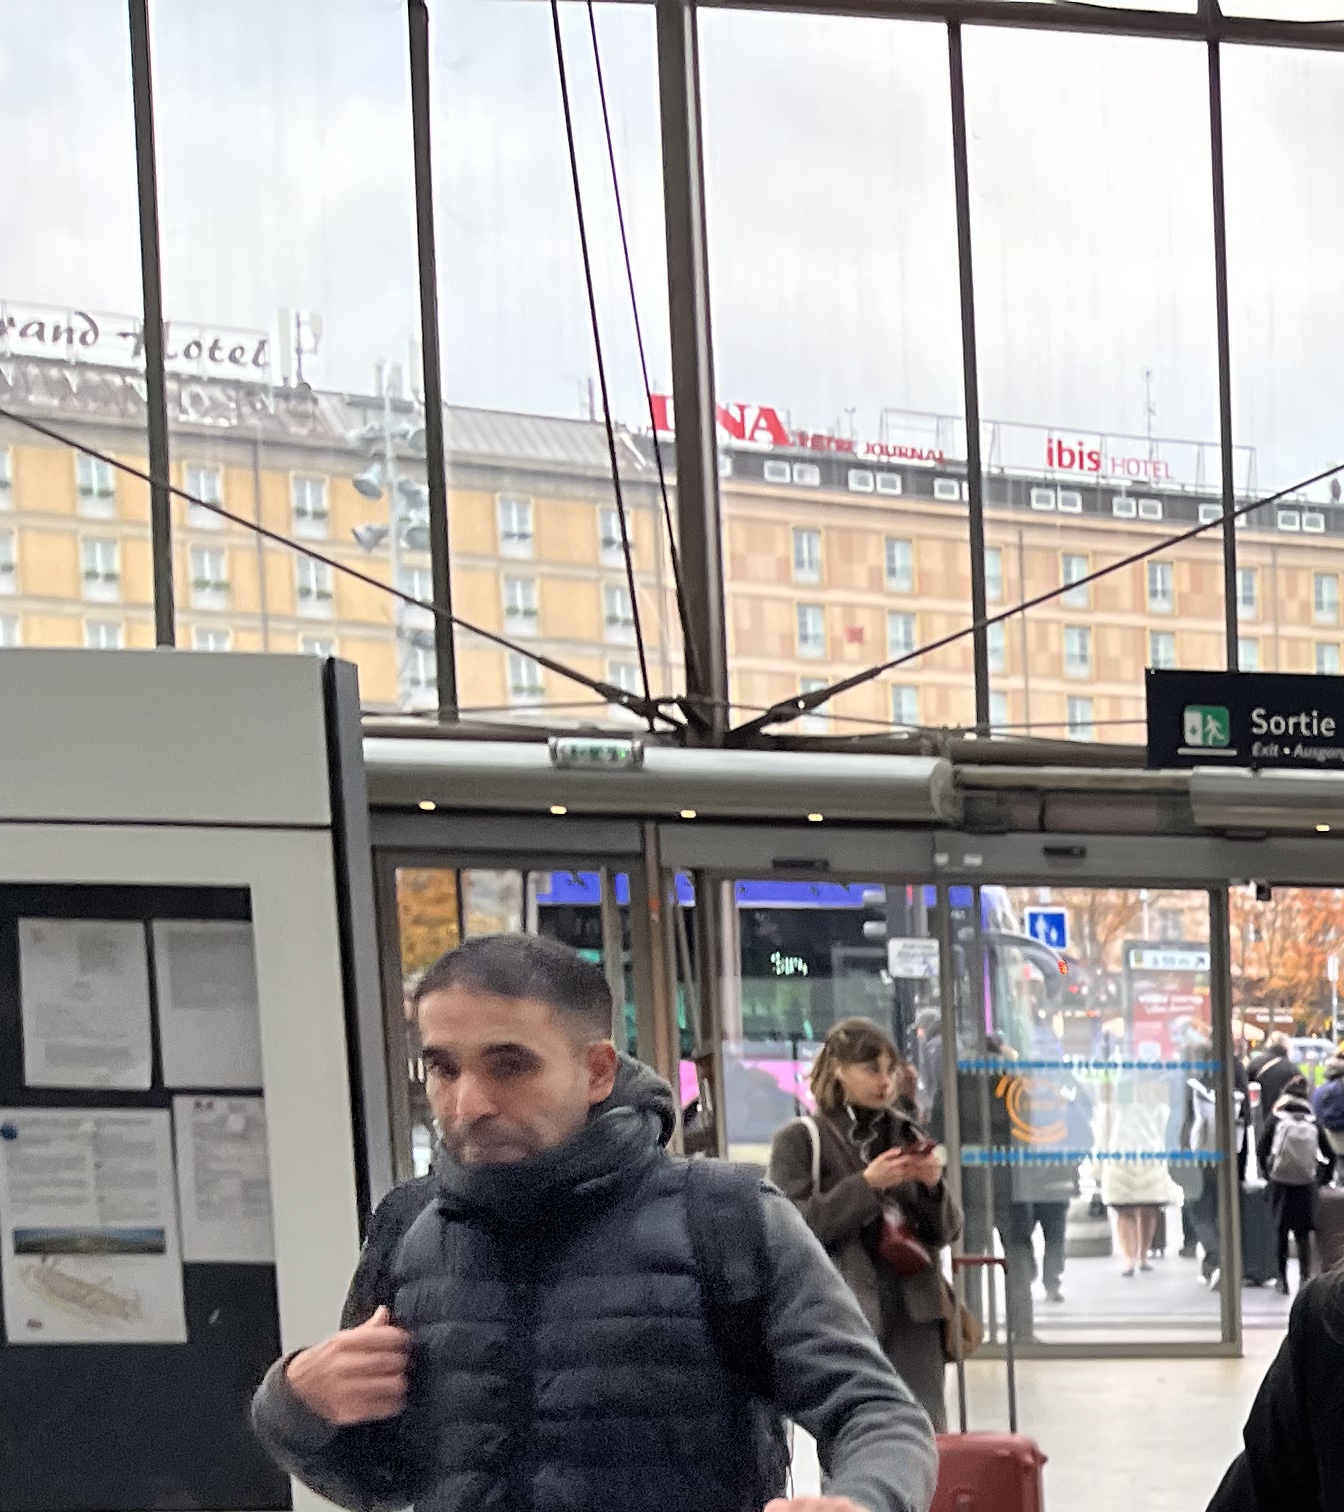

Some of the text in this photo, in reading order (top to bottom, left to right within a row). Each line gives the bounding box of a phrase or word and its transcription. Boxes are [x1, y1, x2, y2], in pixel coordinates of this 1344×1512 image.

[864, 442, 946, 465] JOURNAL
[1046, 436, 1174, 480] ibis HOTEL
[1251, 707, 1336, 738] Sortie
[1251, 741, 1280, 758] Exit
